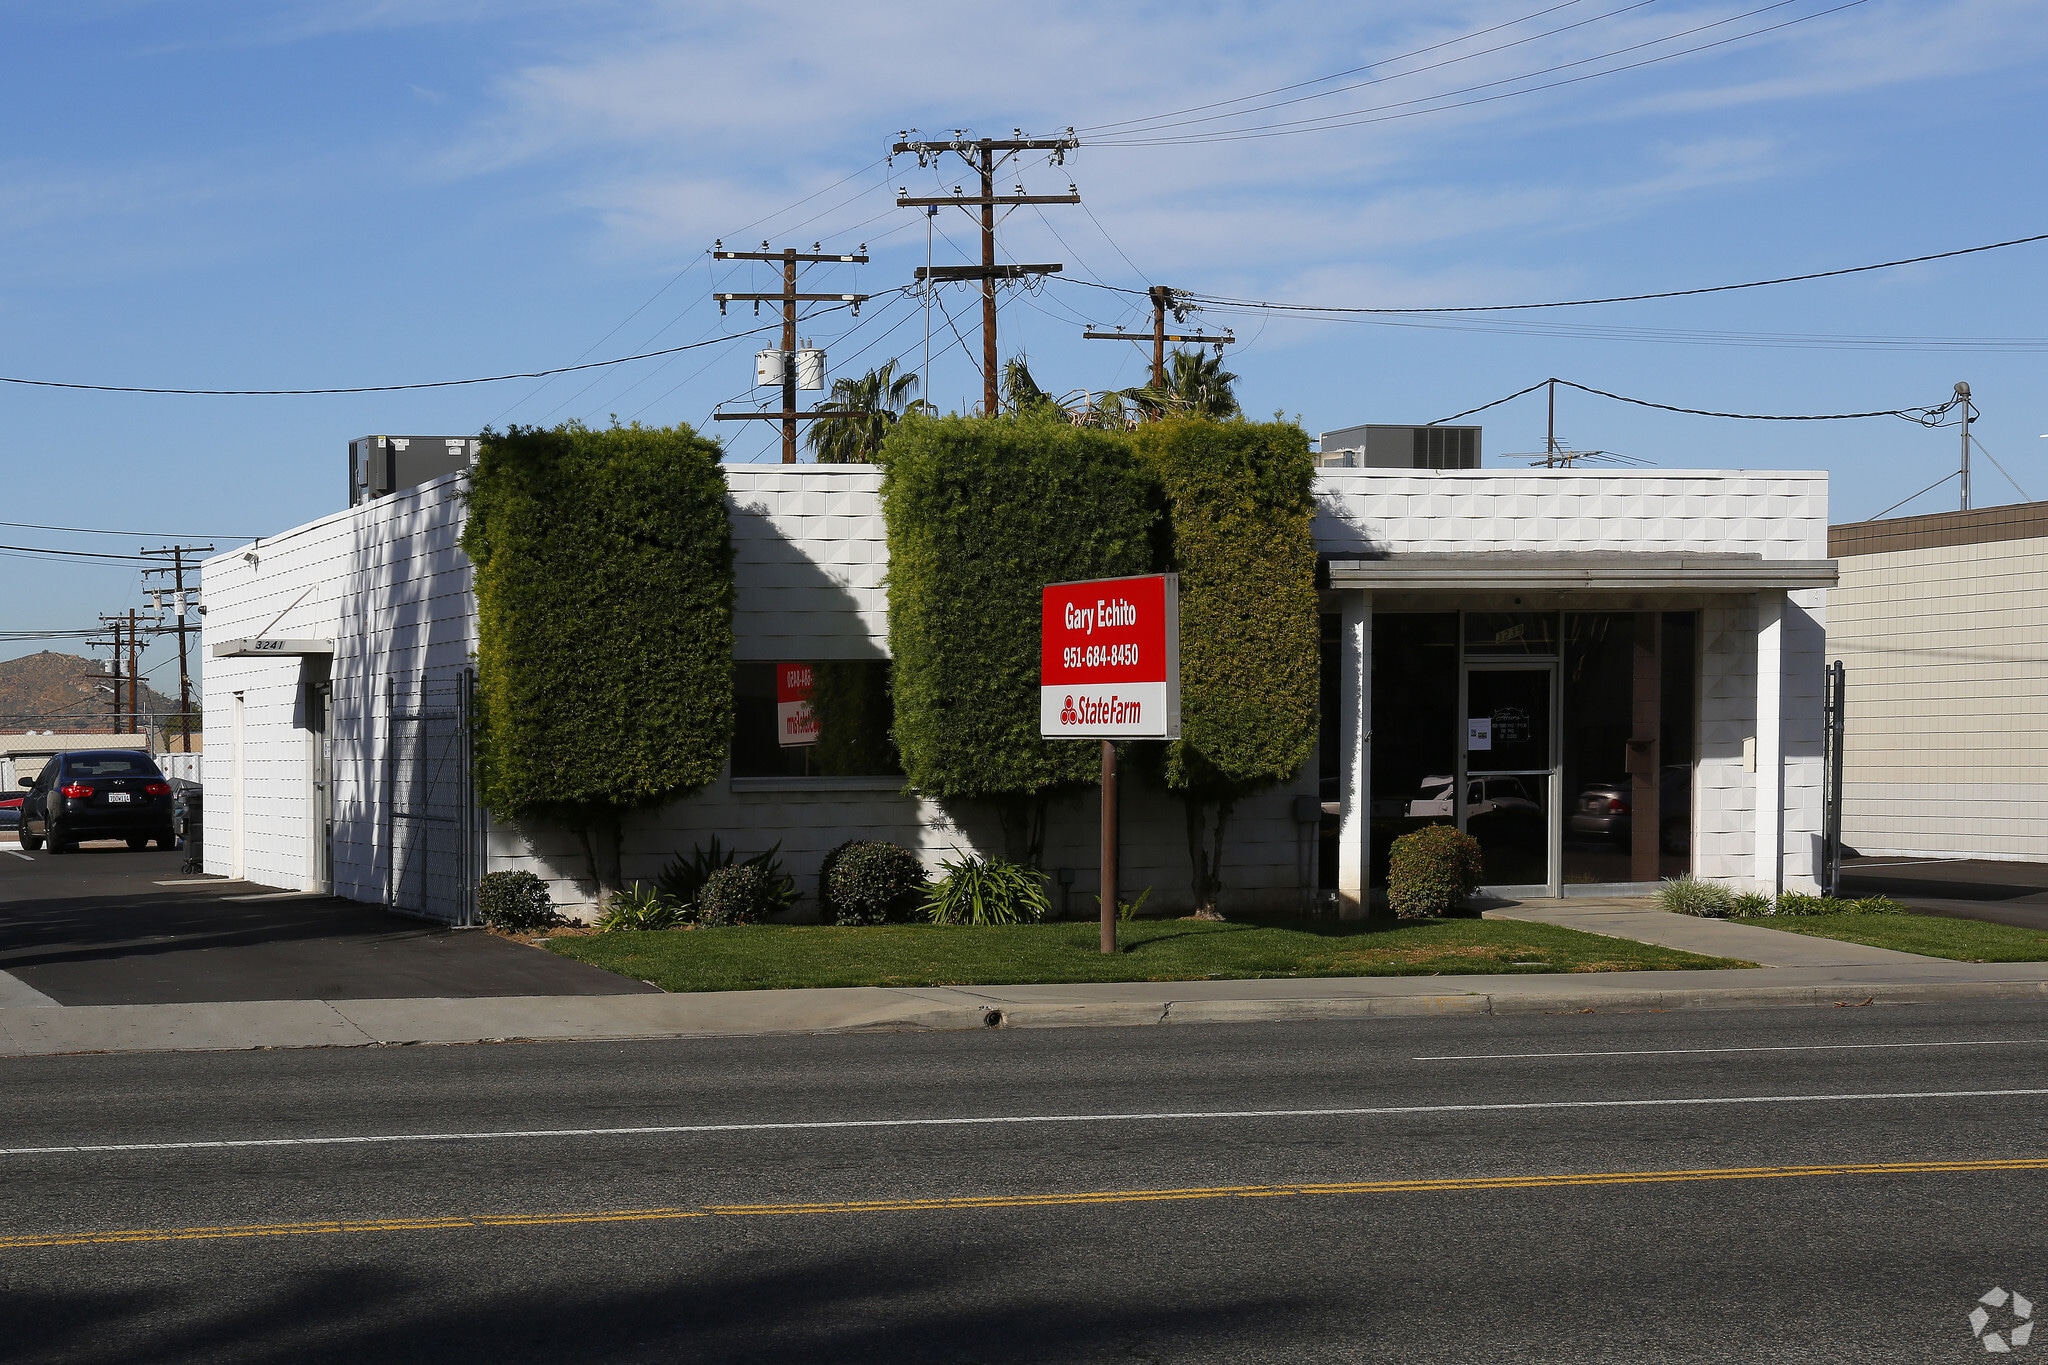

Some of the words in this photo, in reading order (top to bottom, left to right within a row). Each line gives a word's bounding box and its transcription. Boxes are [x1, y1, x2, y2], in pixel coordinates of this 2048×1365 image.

[1065, 602, 1094, 635] Gary
[1097, 598, 1137, 628] Echito
[255, 640, 284, 650] 3241
[1063, 643, 1139, 669] 951-684-8450
